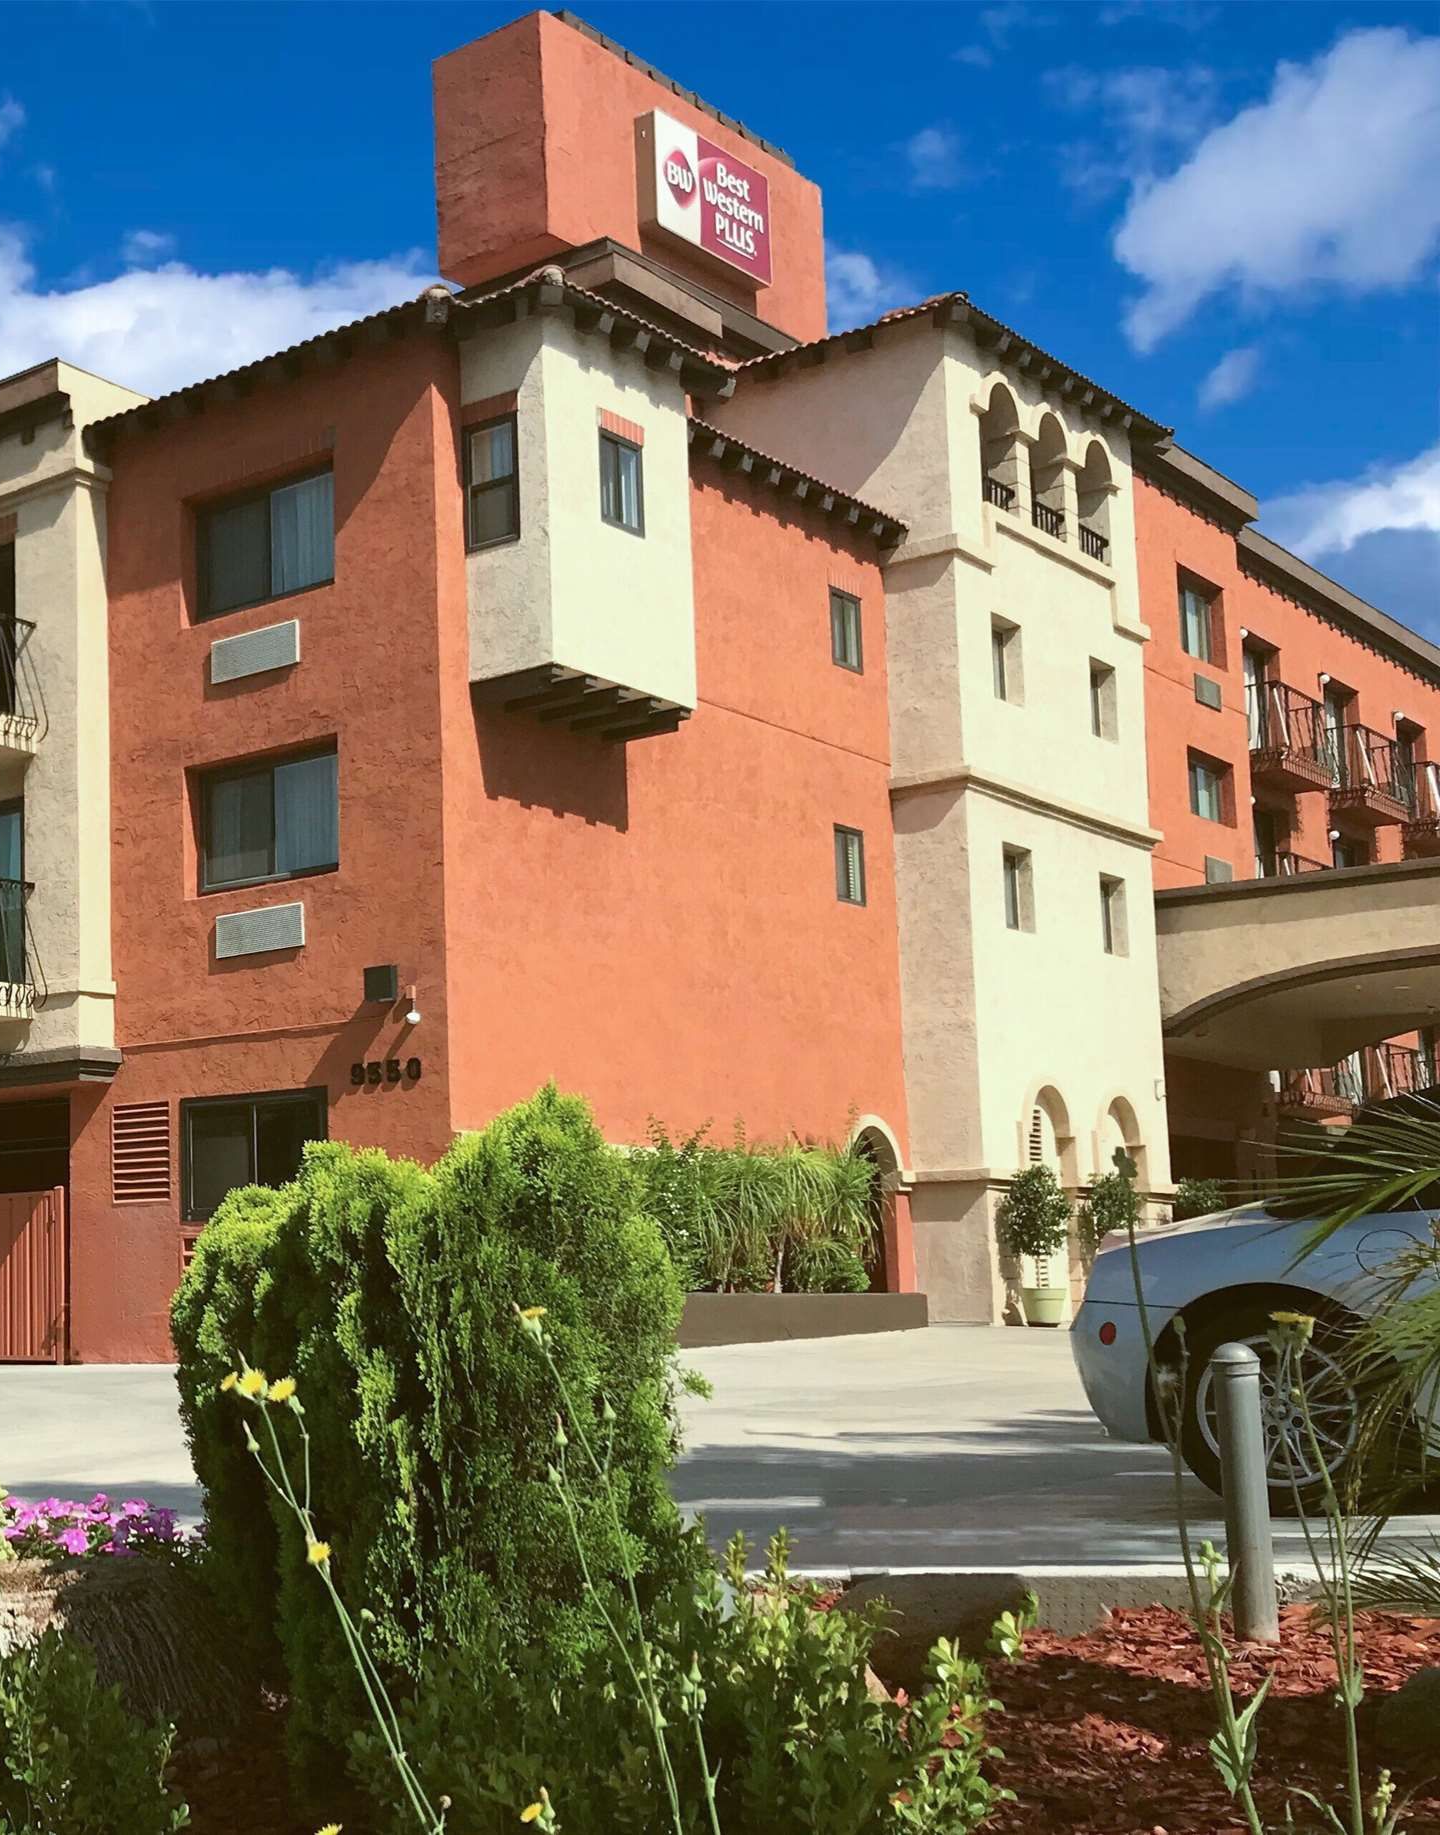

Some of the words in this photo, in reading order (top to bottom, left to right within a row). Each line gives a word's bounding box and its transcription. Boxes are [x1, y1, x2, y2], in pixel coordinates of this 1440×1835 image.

[666, 161, 693, 193] BW
[716, 162, 750, 201] Best
[703, 177, 764, 233] Western
[715, 212, 755, 255] PLUS
